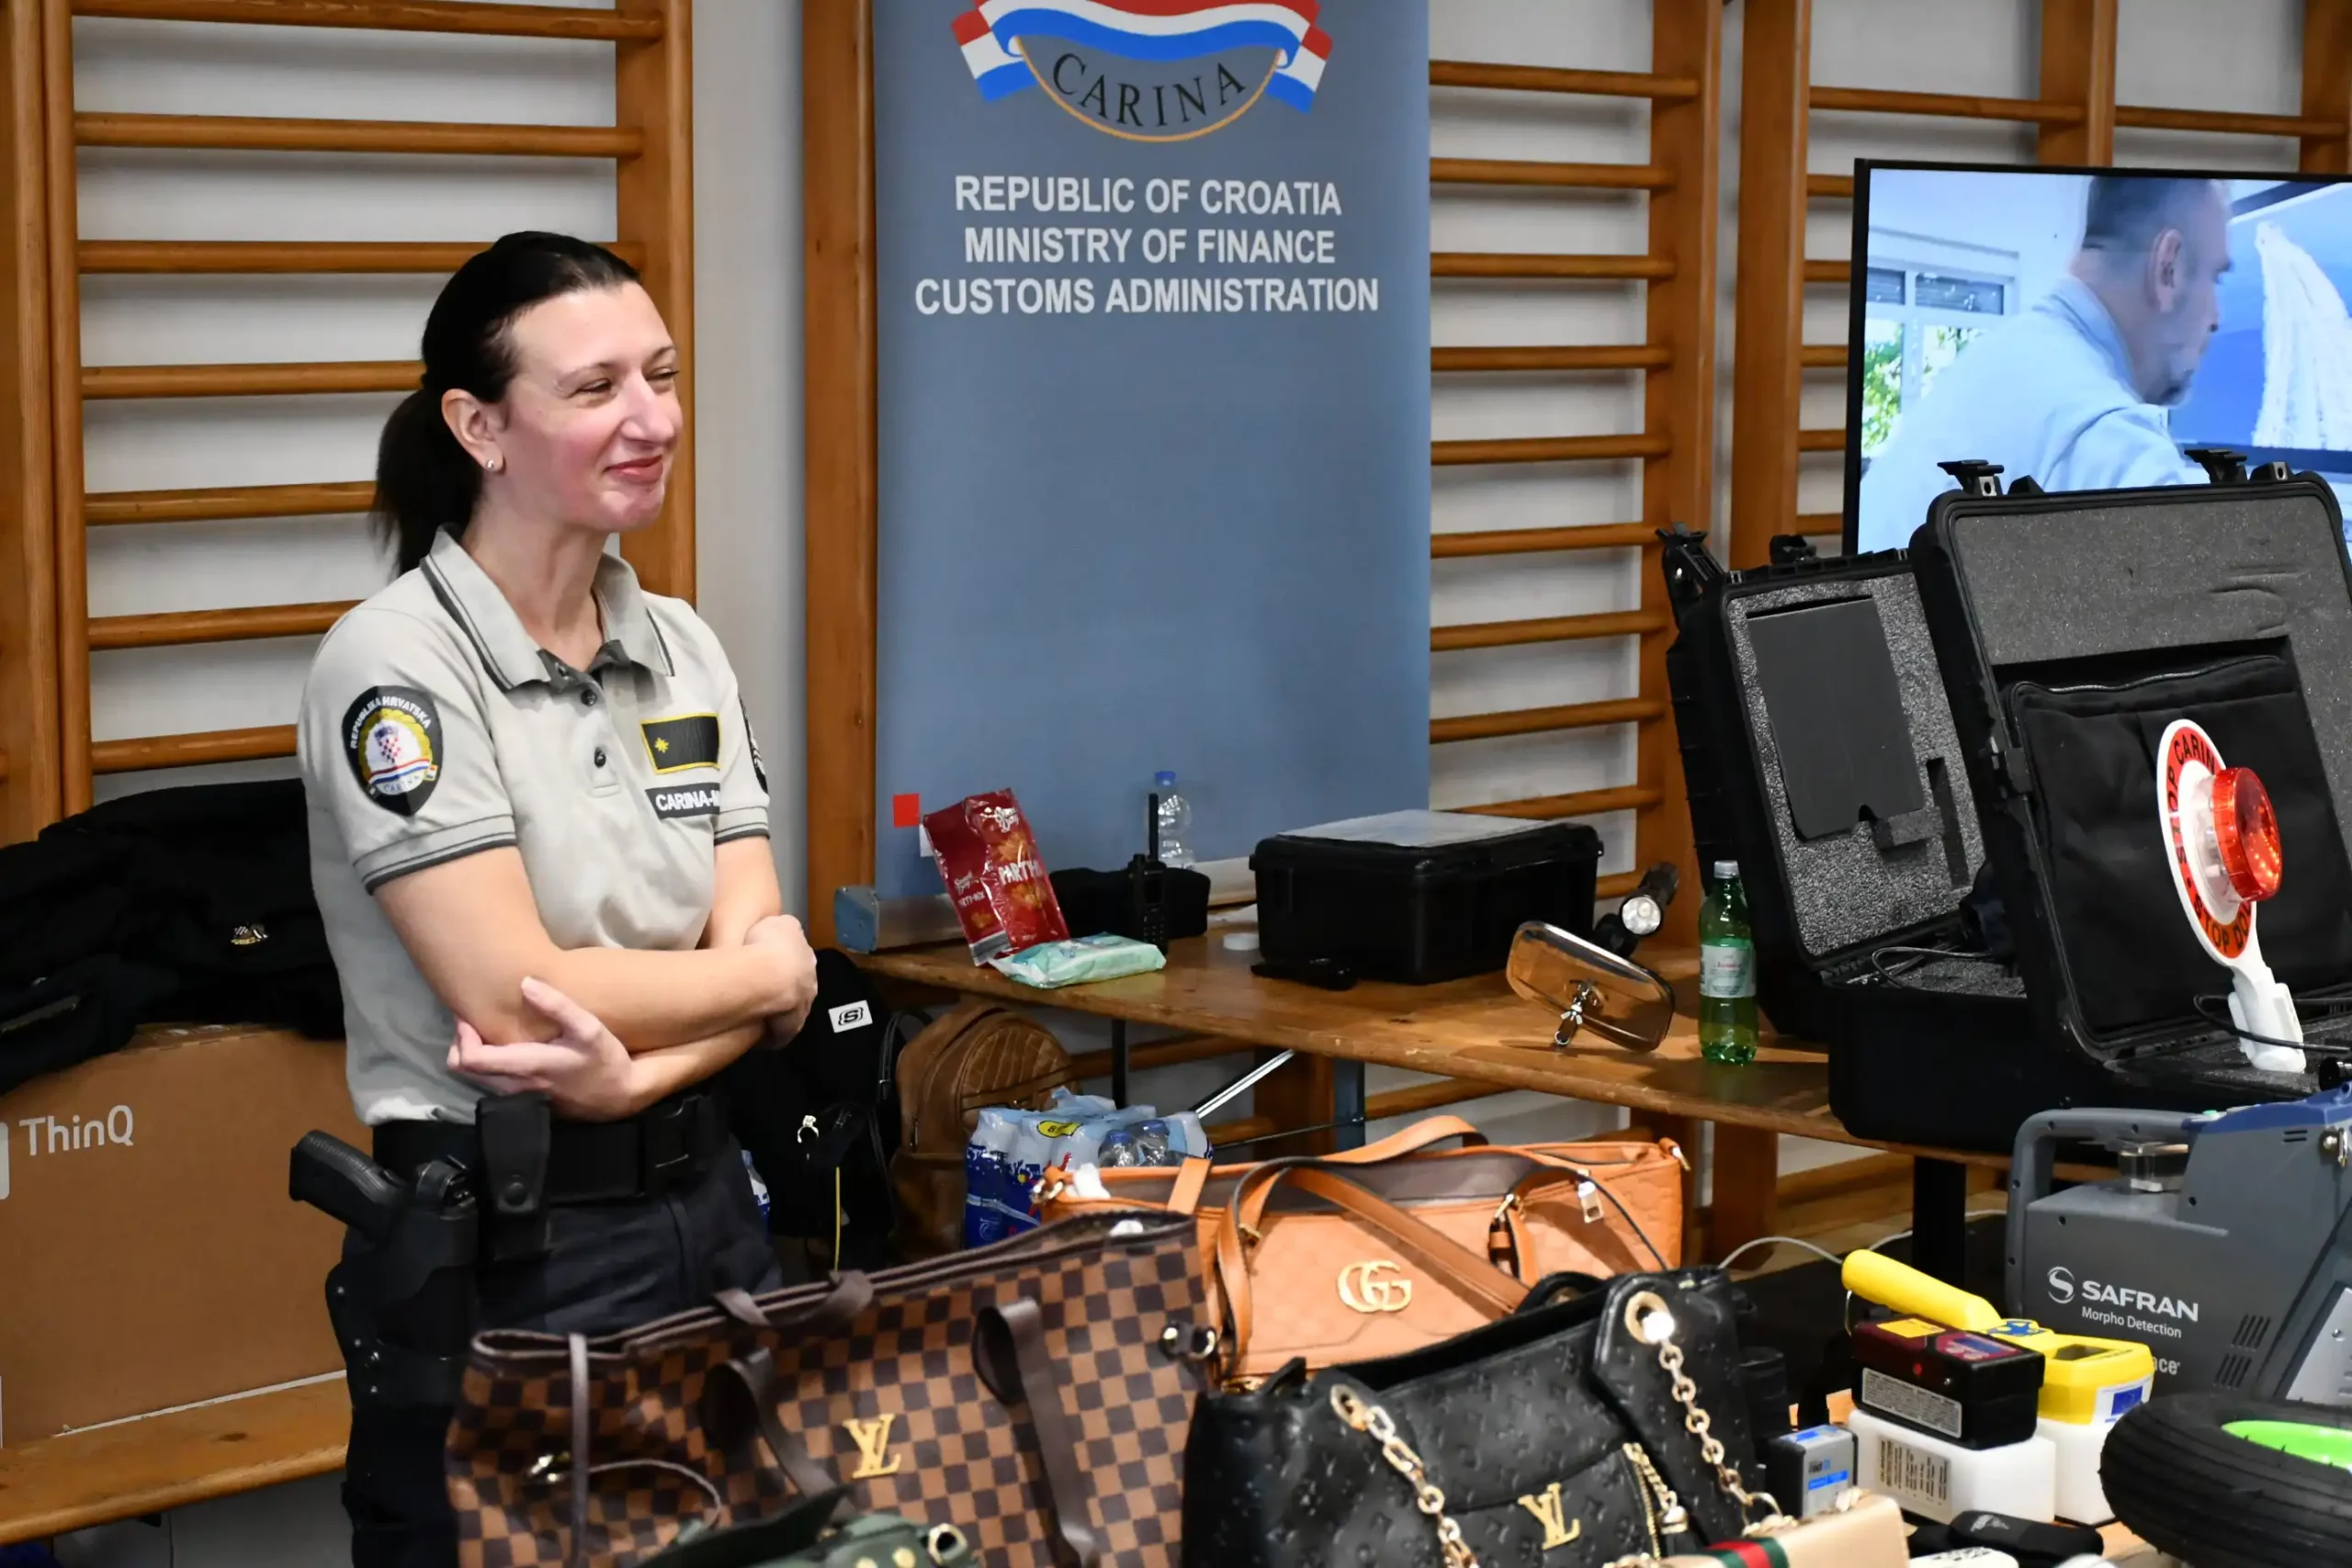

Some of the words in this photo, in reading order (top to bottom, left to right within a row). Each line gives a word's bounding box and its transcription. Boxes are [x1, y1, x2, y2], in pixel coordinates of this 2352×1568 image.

[1053, 52, 1247, 127] CARINA
[955, 175, 1136, 213] REPUBLIC
[1145, 178, 1191, 214] OF
[1200, 179, 1342, 216] CROATIA
[964, 226, 1133, 264] MINISTRY
[1142, 228, 1187, 264] OF
[1197, 229, 1336, 264] FINANCE
[915, 277, 1095, 315] CUSTOMS
[1104, 276, 1378, 313] ADMINISTRATION
[350, 698, 381, 749] REPUBLIKA
[381, 695, 432, 728] HRVATSKA
[2173, 731, 2216, 776] CARIN
[18, 1104, 134, 1156] ThinQ
[2081, 1280, 2199, 1323] SAFRAN
[2081, 1305, 2125, 1325] Morpho
[2127, 1315, 2182, 1338] Detection
